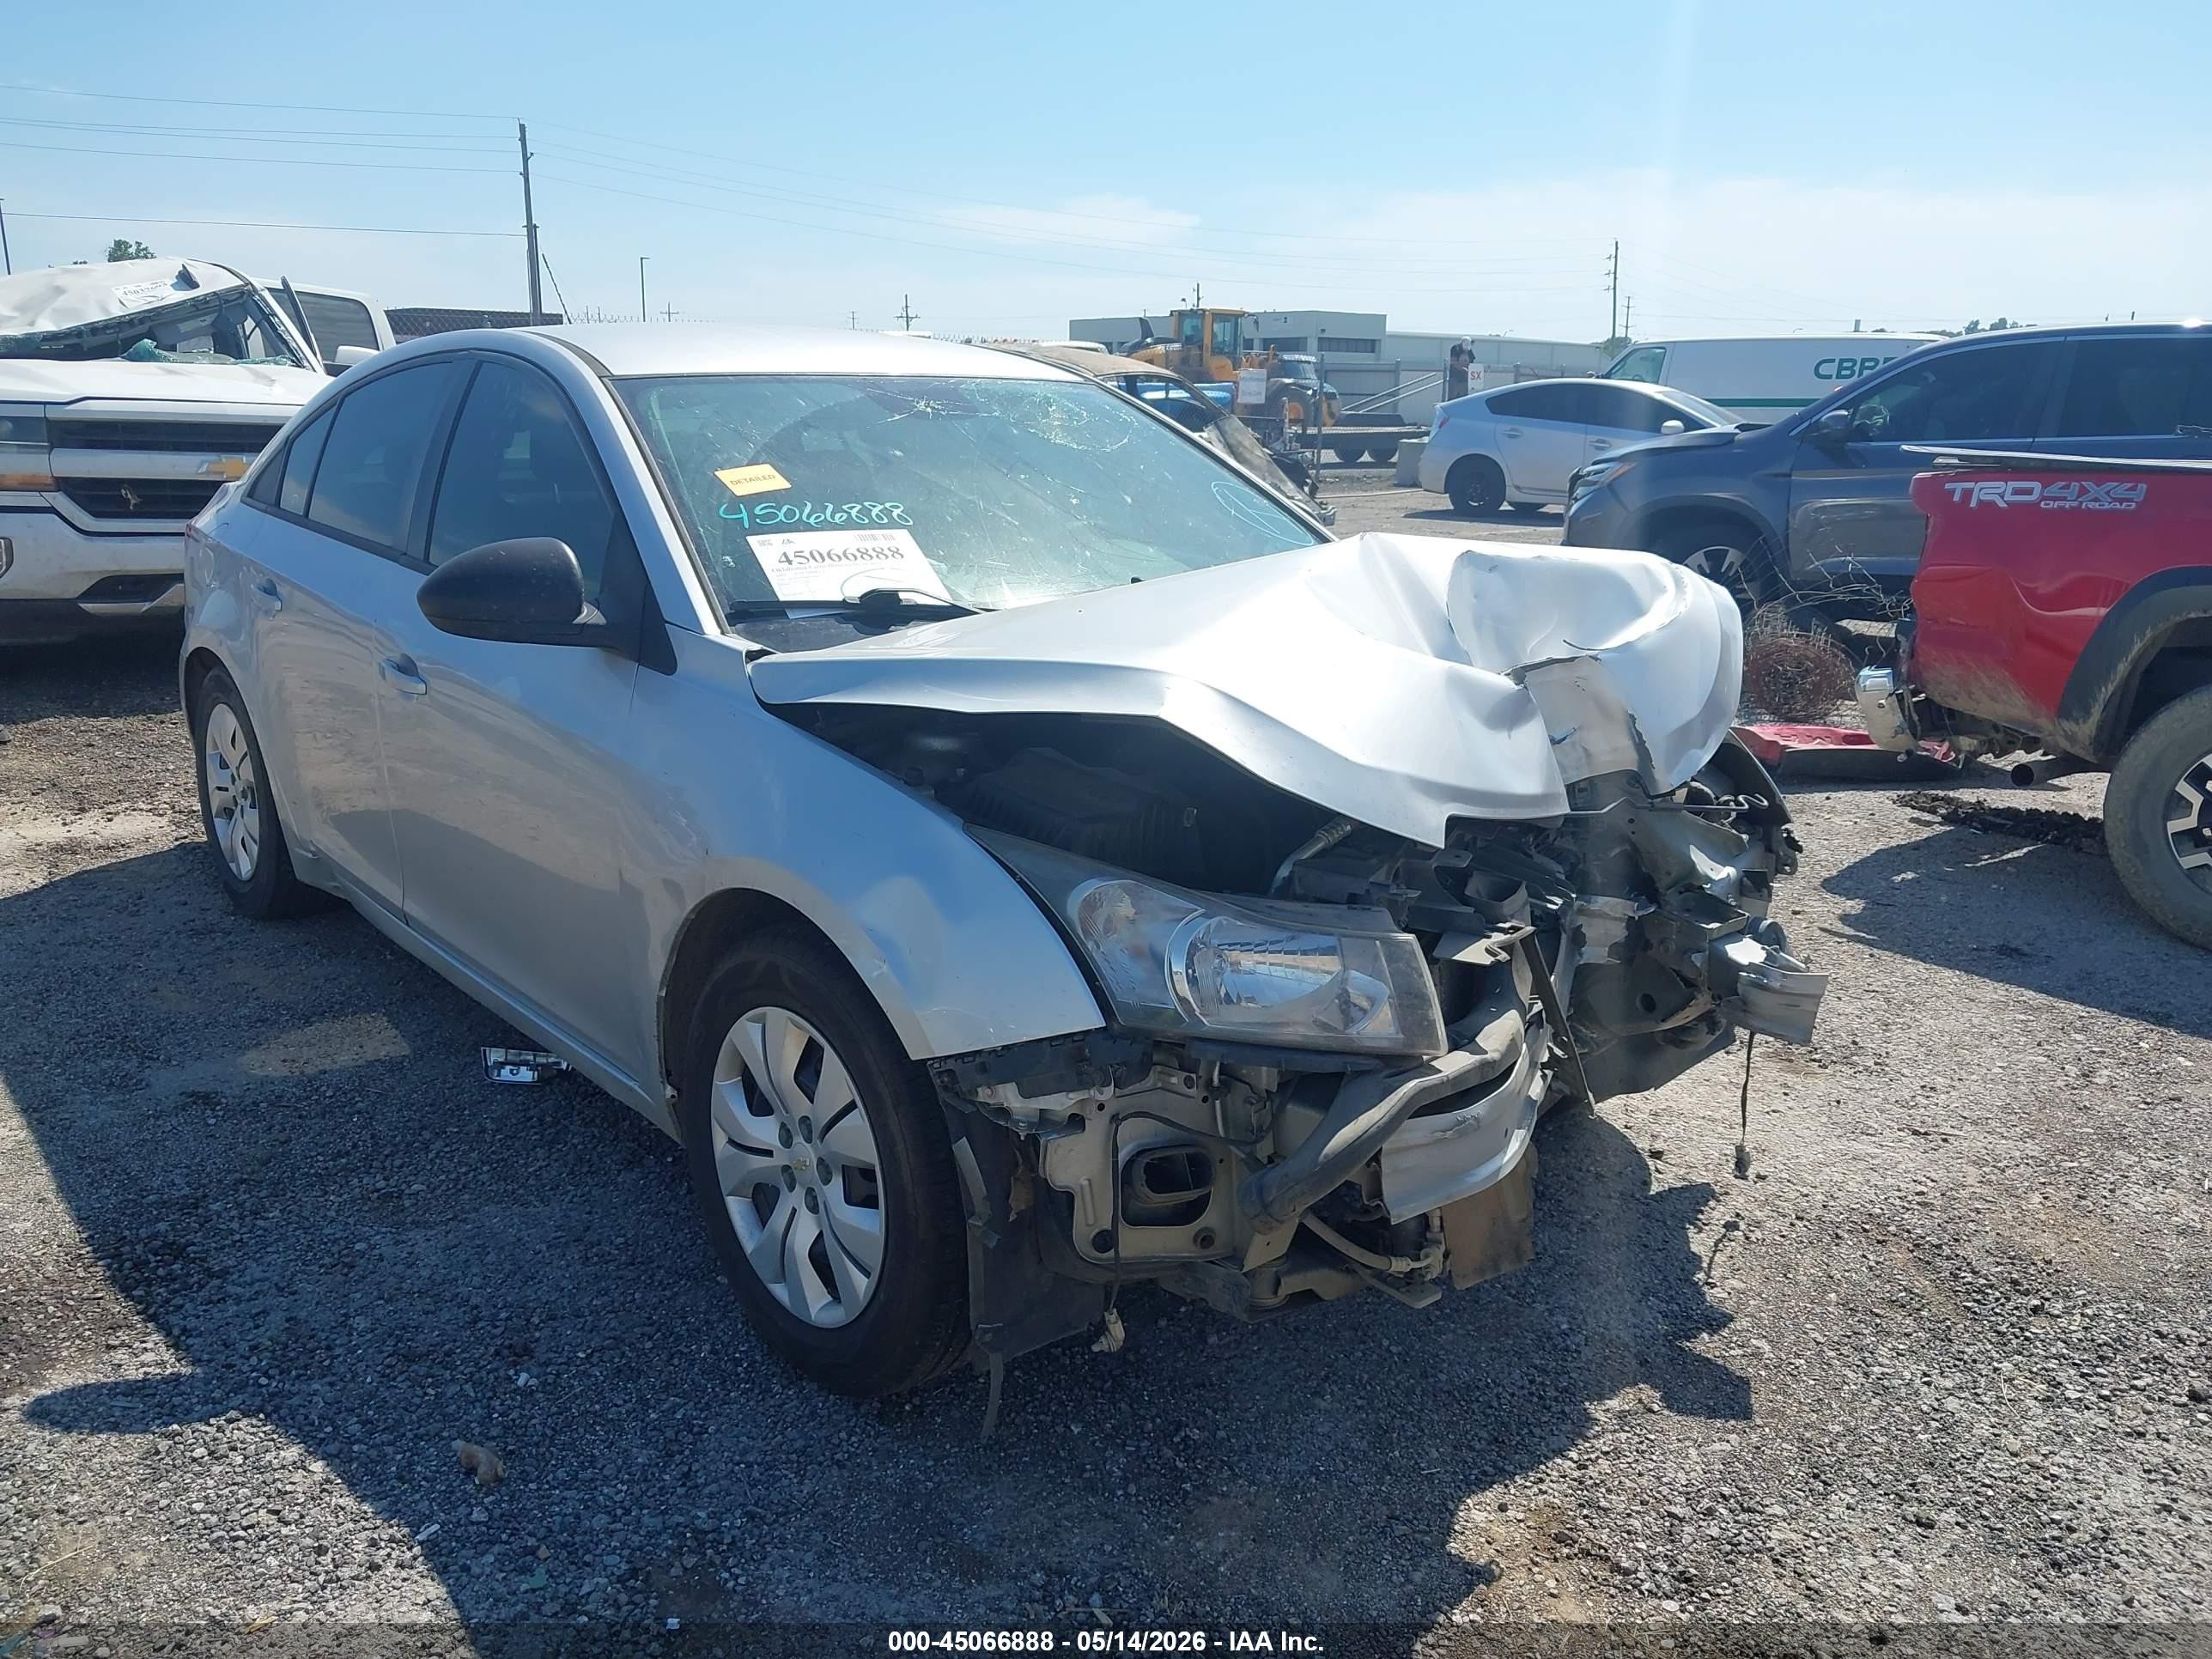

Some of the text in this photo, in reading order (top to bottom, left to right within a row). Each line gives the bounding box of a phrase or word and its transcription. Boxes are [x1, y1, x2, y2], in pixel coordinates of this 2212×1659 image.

[729, 474, 776, 486] DETAILED
[1944, 481, 2147, 507] TRD 4X4
[719, 501, 914, 529] 45066888
[2081, 501, 2136, 509] ROAD
[778, 546, 904, 566] 45066888
